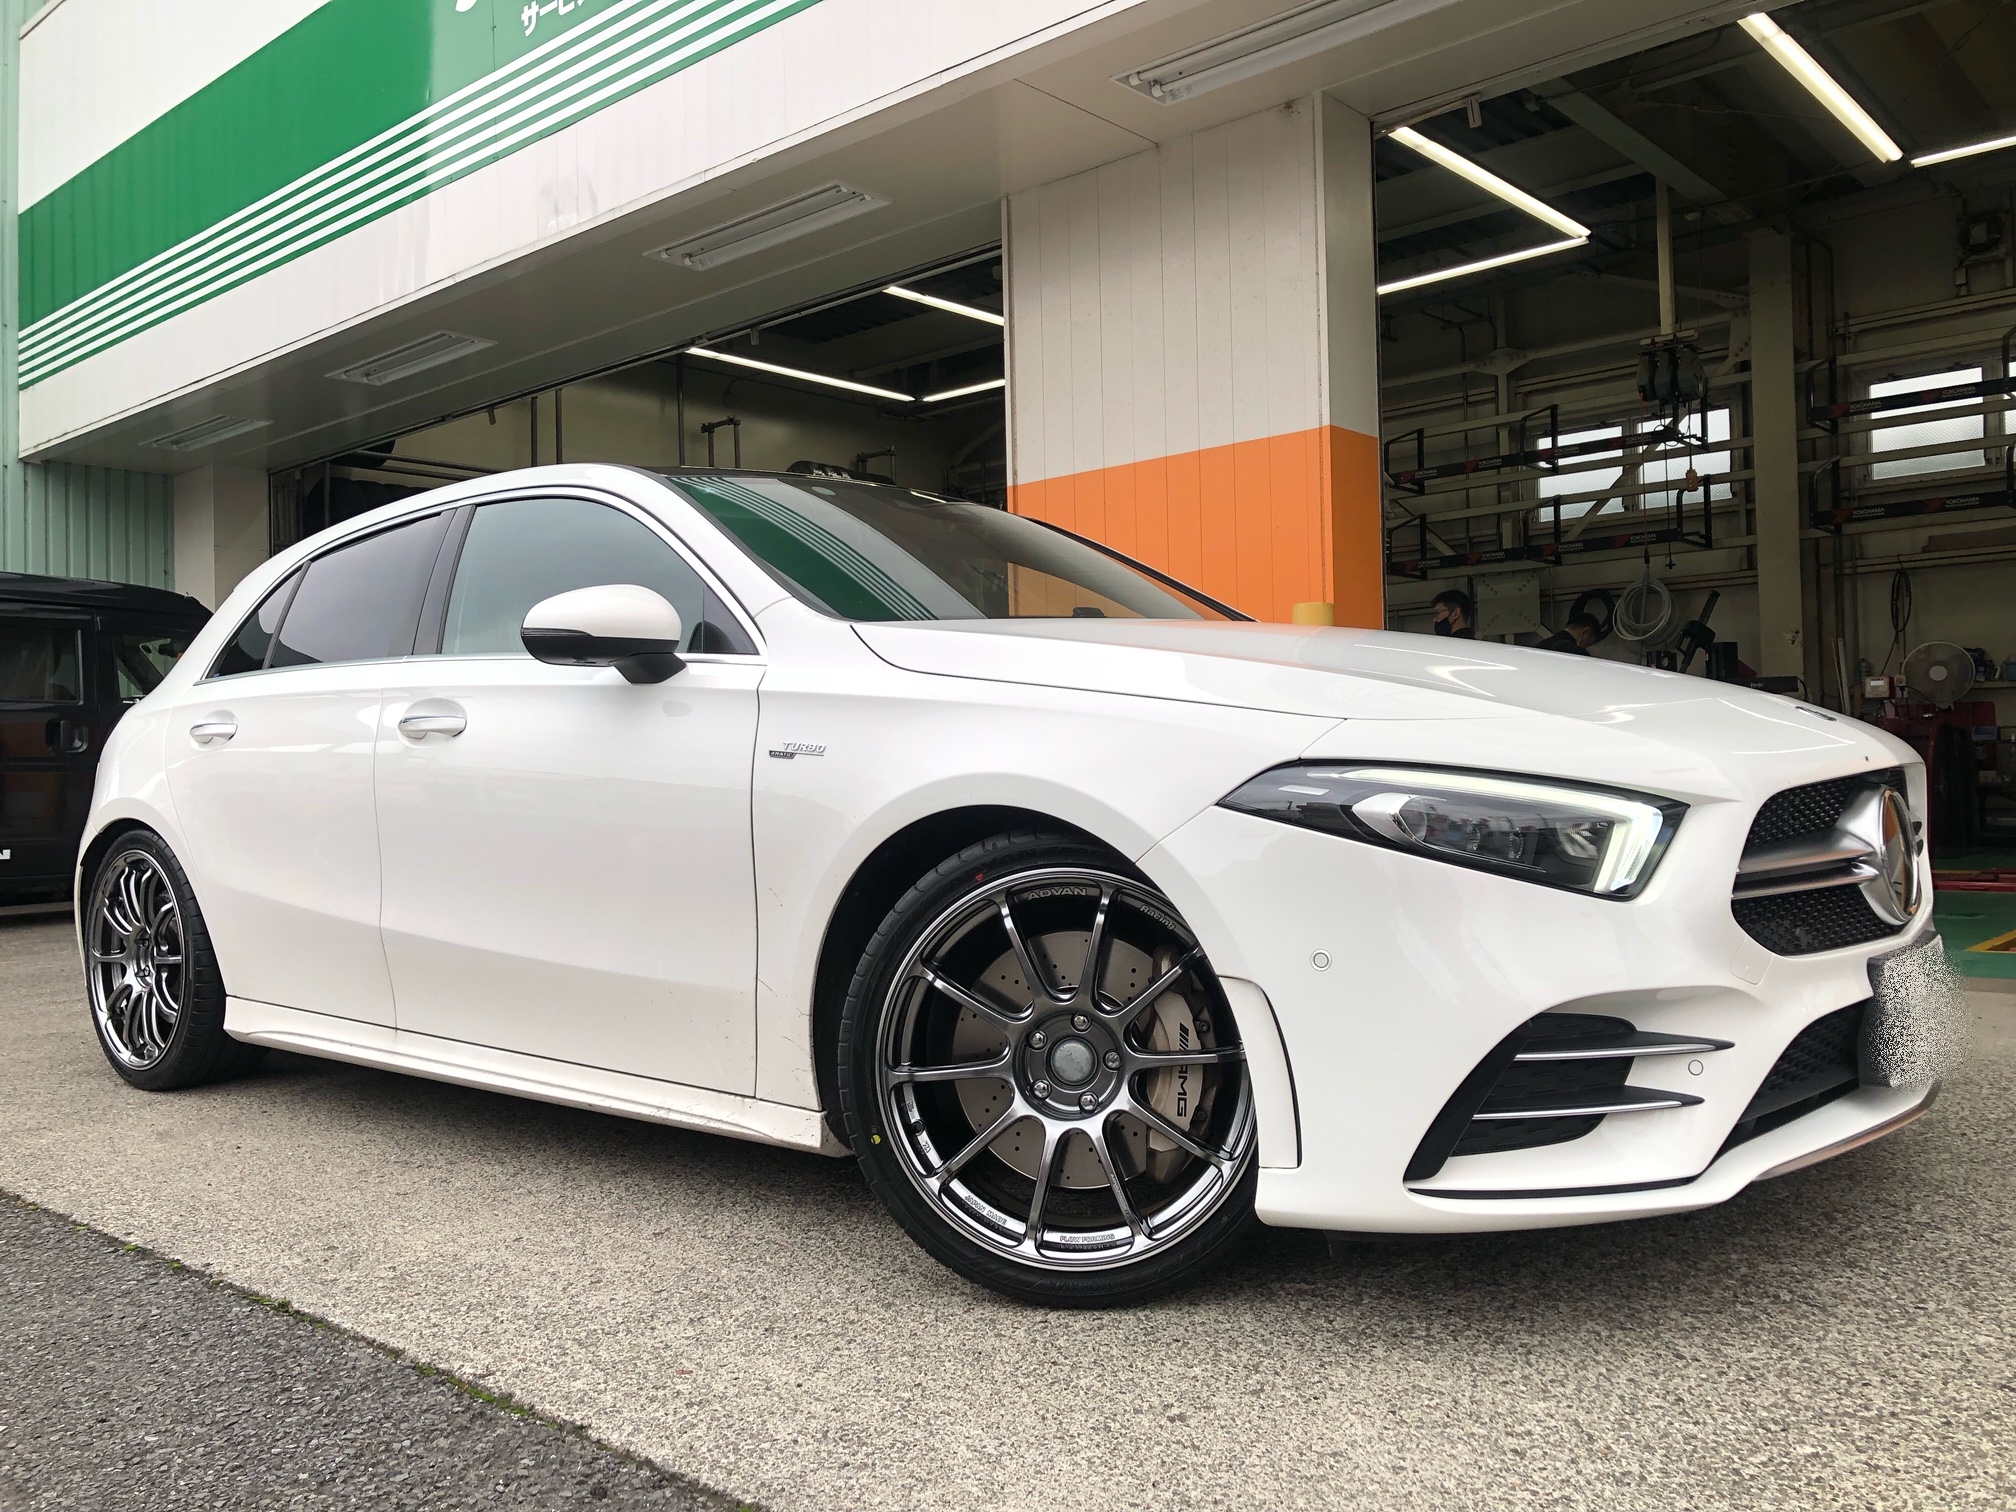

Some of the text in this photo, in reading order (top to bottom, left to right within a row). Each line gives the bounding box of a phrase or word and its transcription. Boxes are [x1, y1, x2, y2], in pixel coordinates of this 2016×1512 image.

[1945, 497, 1979, 505] YOKOHAMA
[1852, 508, 1885, 516] YOKOHAMA
[783, 741, 827, 753] TURBO
[1027, 887, 1088, 901] ADVAN
[1139, 904, 1176, 931] Racing
[964, 1194, 1008, 1226] JAPAN MADE
[1059, 1232, 1116, 1243] FLOW FORMING
